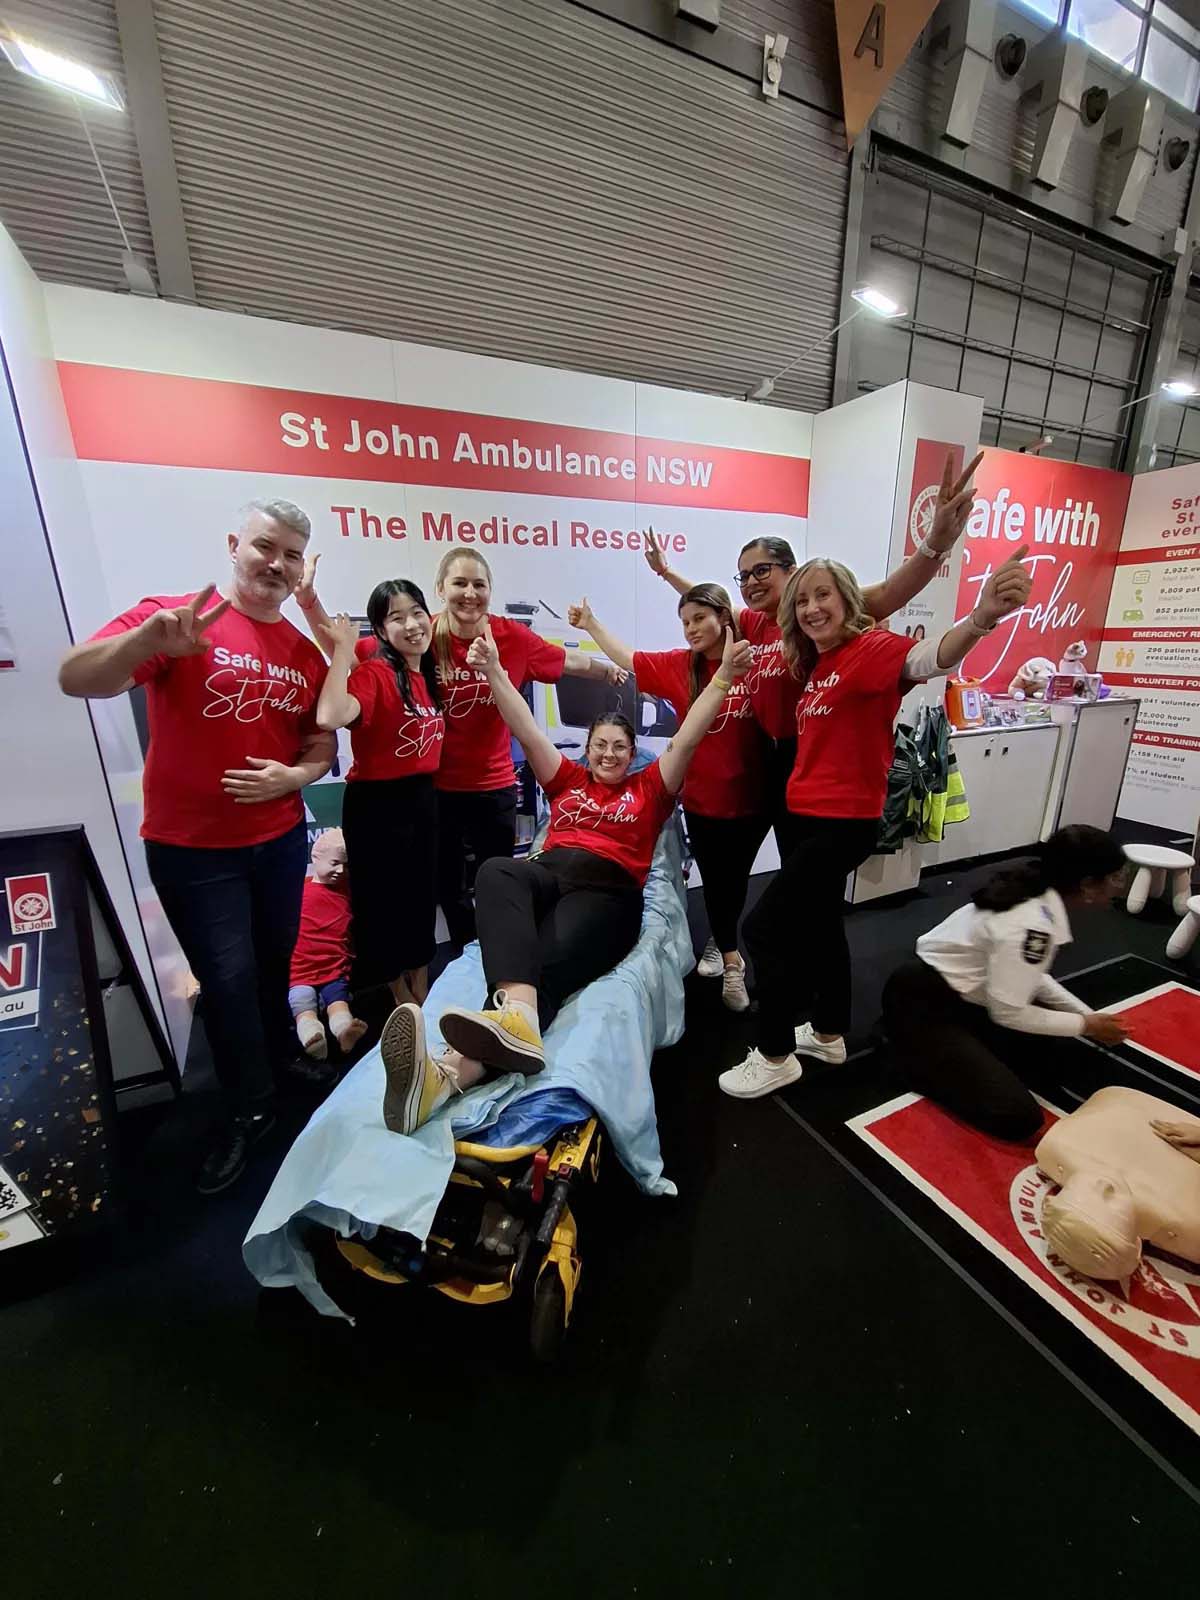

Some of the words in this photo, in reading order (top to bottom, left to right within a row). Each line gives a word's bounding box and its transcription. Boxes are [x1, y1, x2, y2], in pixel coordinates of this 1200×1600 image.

[854, 3, 886, 68] A
[279, 411, 330, 451] St
[343, 419, 439, 461] John
[452, 432, 636, 480] Ambulance
[647, 455, 713, 488] NSW
[331, 506, 407, 540] The
[421, 511, 558, 548] Medical
[966, 488, 1025, 540] afe
[1034, 498, 1100, 547] with
[1176, 511, 1195, 524] St
[1166, 548, 1196, 558] EVENT
[213, 646, 262, 673] Safe
[267, 663, 308, 689] with
[1133, 677, 1184, 686] VOLUNTEER
[203, 668, 256, 718] St
[235, 679, 305, 723] John
[1167, 714, 1191, 722] hours
[1154, 752, 1170, 760] first
[1150, 772, 1185, 781] students
[14, 924, 25, 933] St
[29, 920, 54, 931] John
[1148, 1320, 1190, 1348] ST
